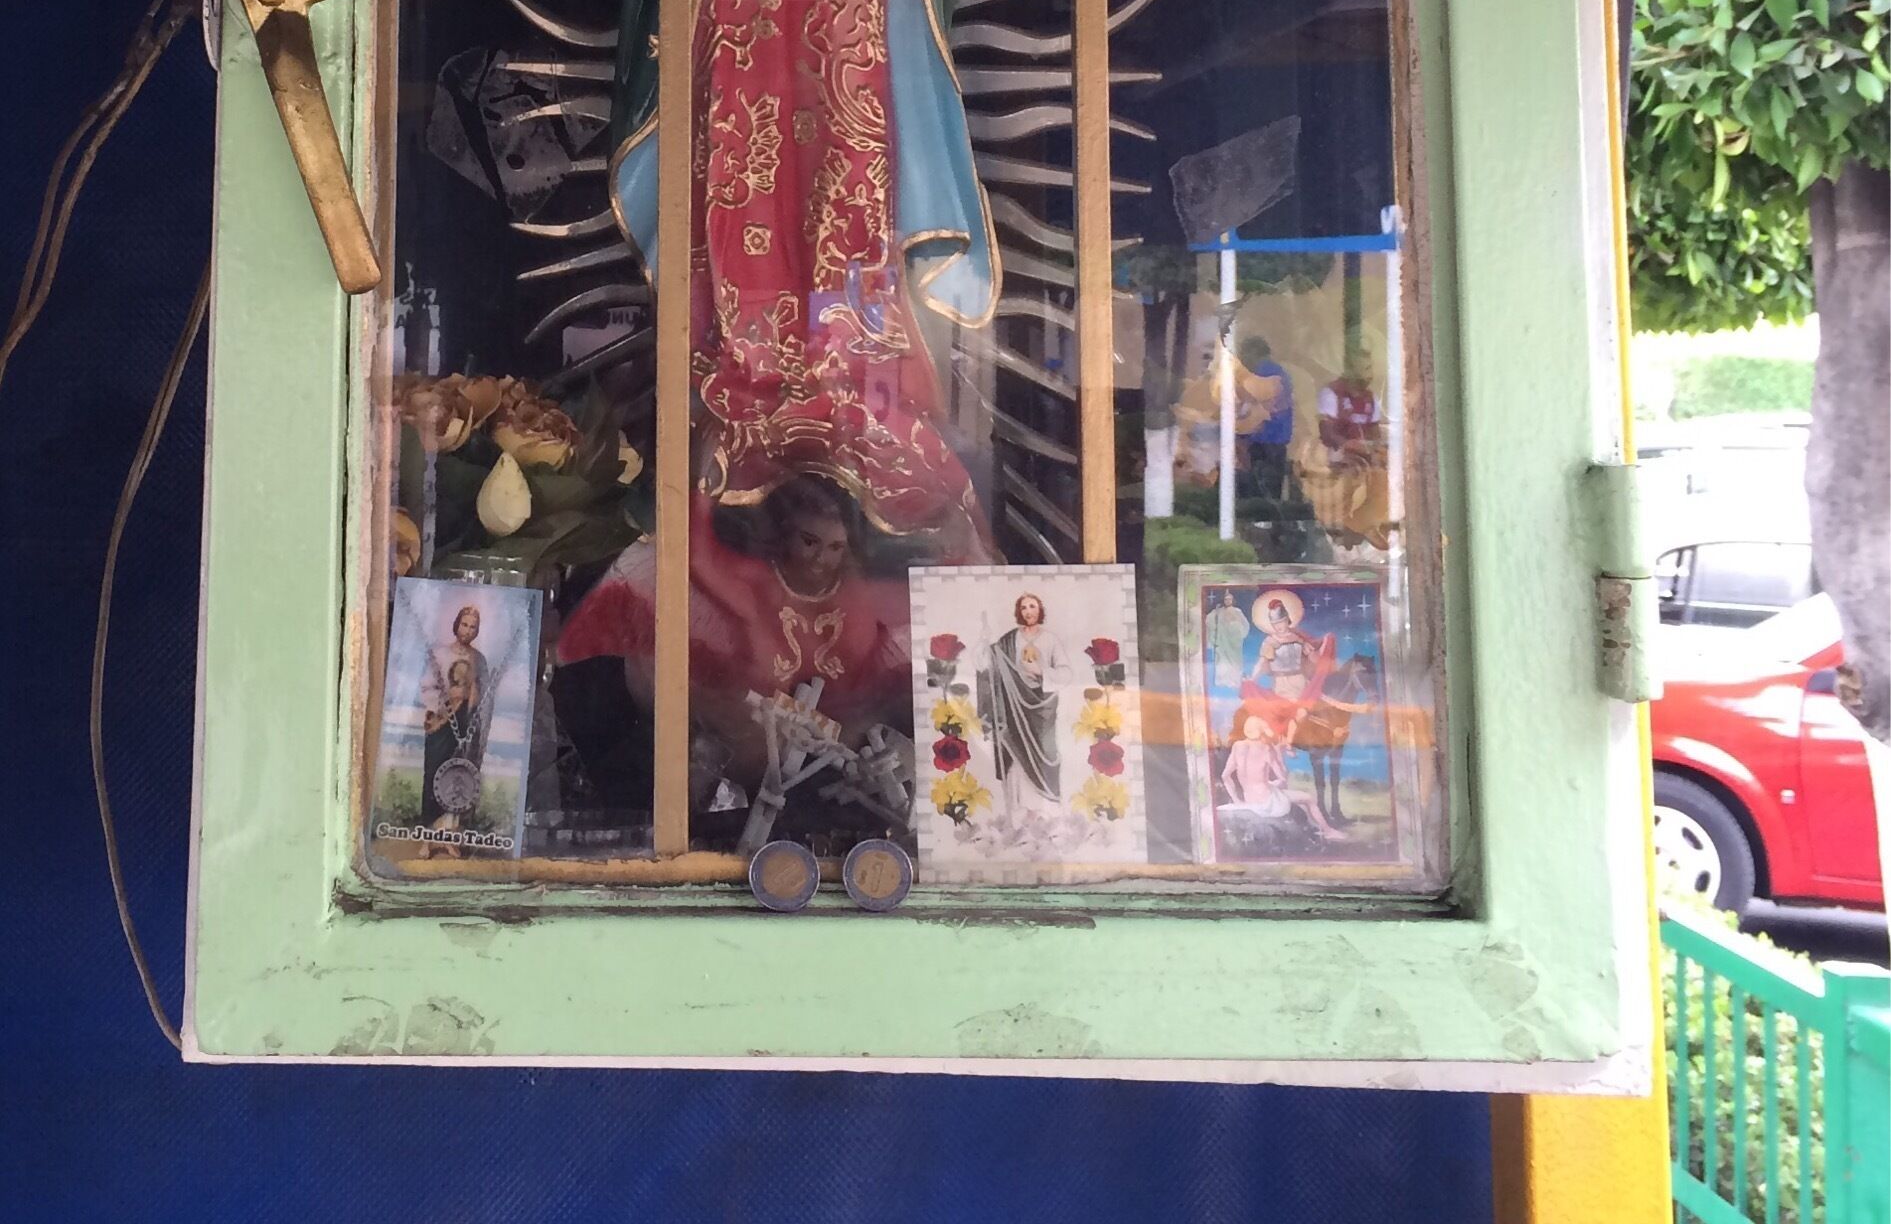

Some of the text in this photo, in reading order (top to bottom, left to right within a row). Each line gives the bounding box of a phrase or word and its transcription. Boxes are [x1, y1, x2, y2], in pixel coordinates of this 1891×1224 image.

[377, 823, 514, 850] San Judas Tadeo
